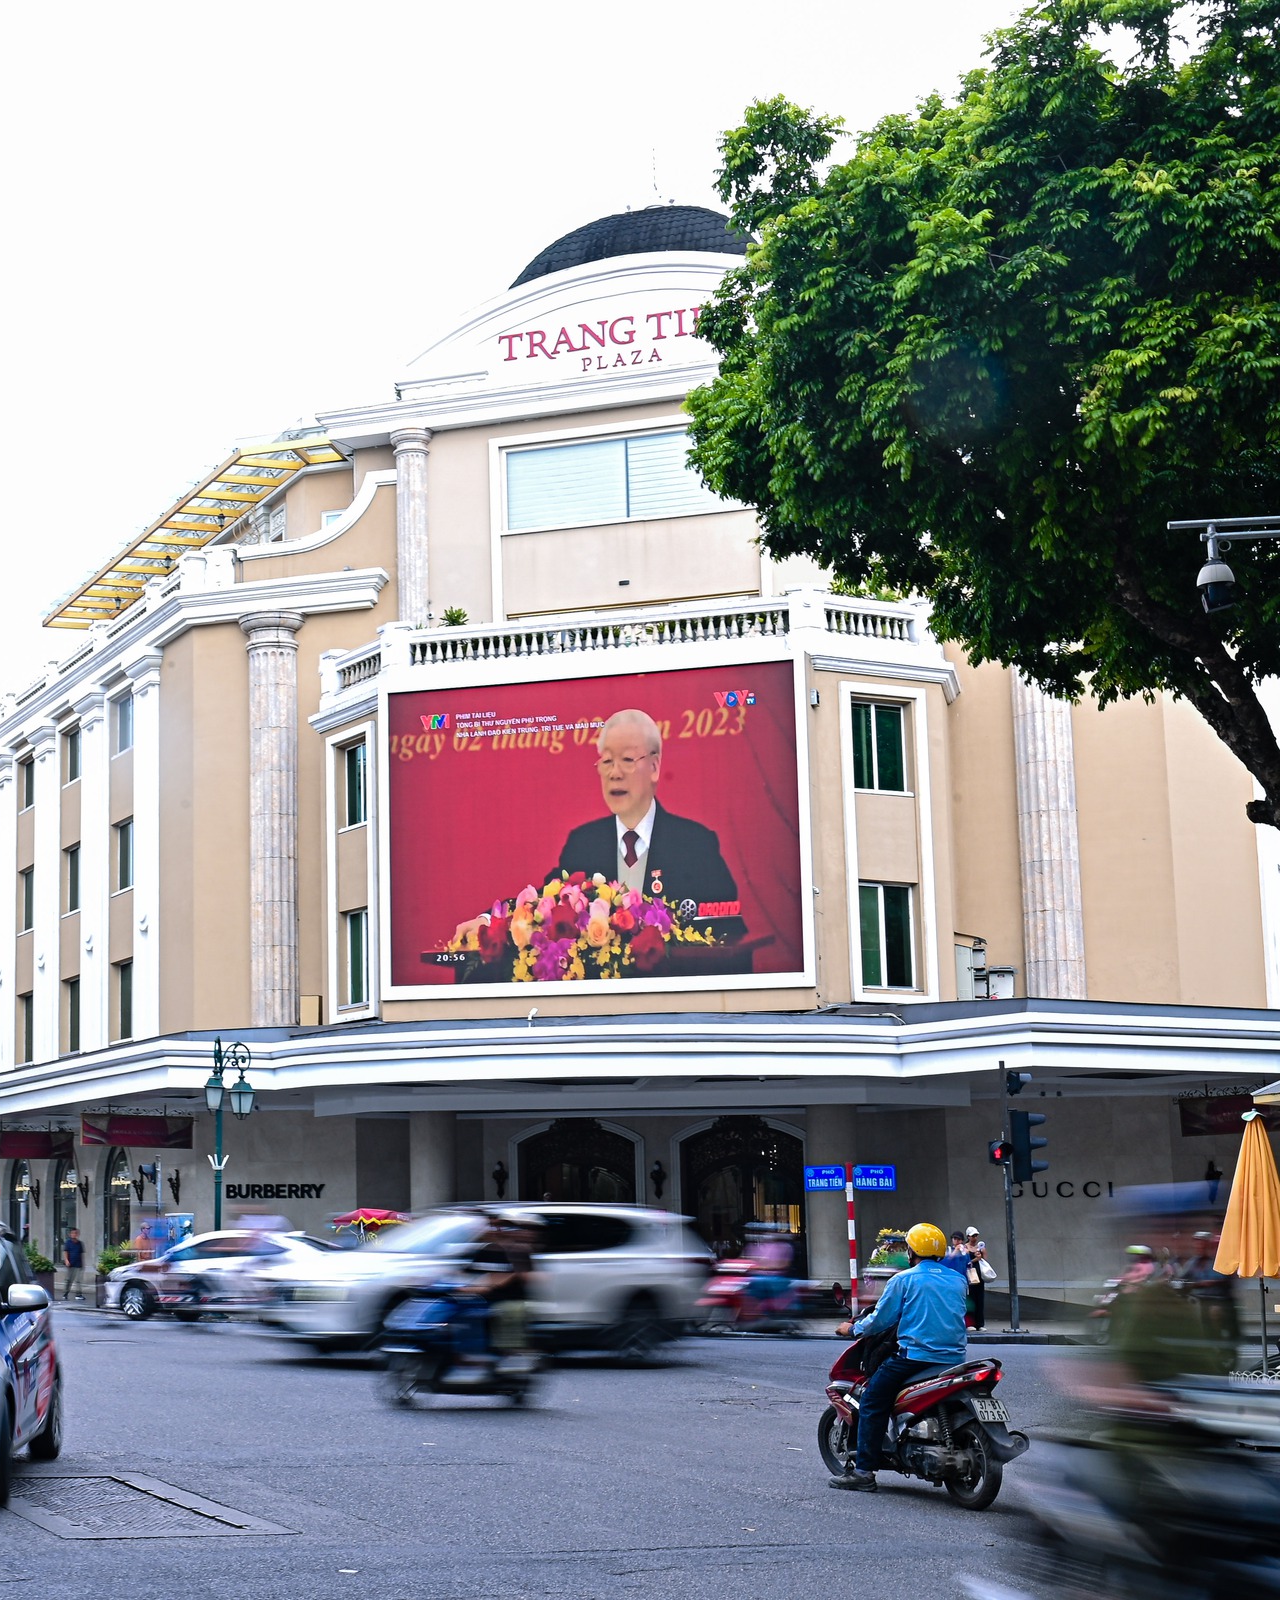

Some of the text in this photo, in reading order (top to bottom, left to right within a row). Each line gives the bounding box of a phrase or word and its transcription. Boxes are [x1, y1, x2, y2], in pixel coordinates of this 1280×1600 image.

[498, 315, 636, 362] TRANG
[581, 348, 662, 372] PLAZA
[679, 706, 747, 738] 2023
[436, 953, 466, 962] 20:56
[225, 1184, 325, 1199] BURBERRY
[1012, 1181, 1114, 1198] GUCCI
[979, 1411, 1008, 1420] 073.61
